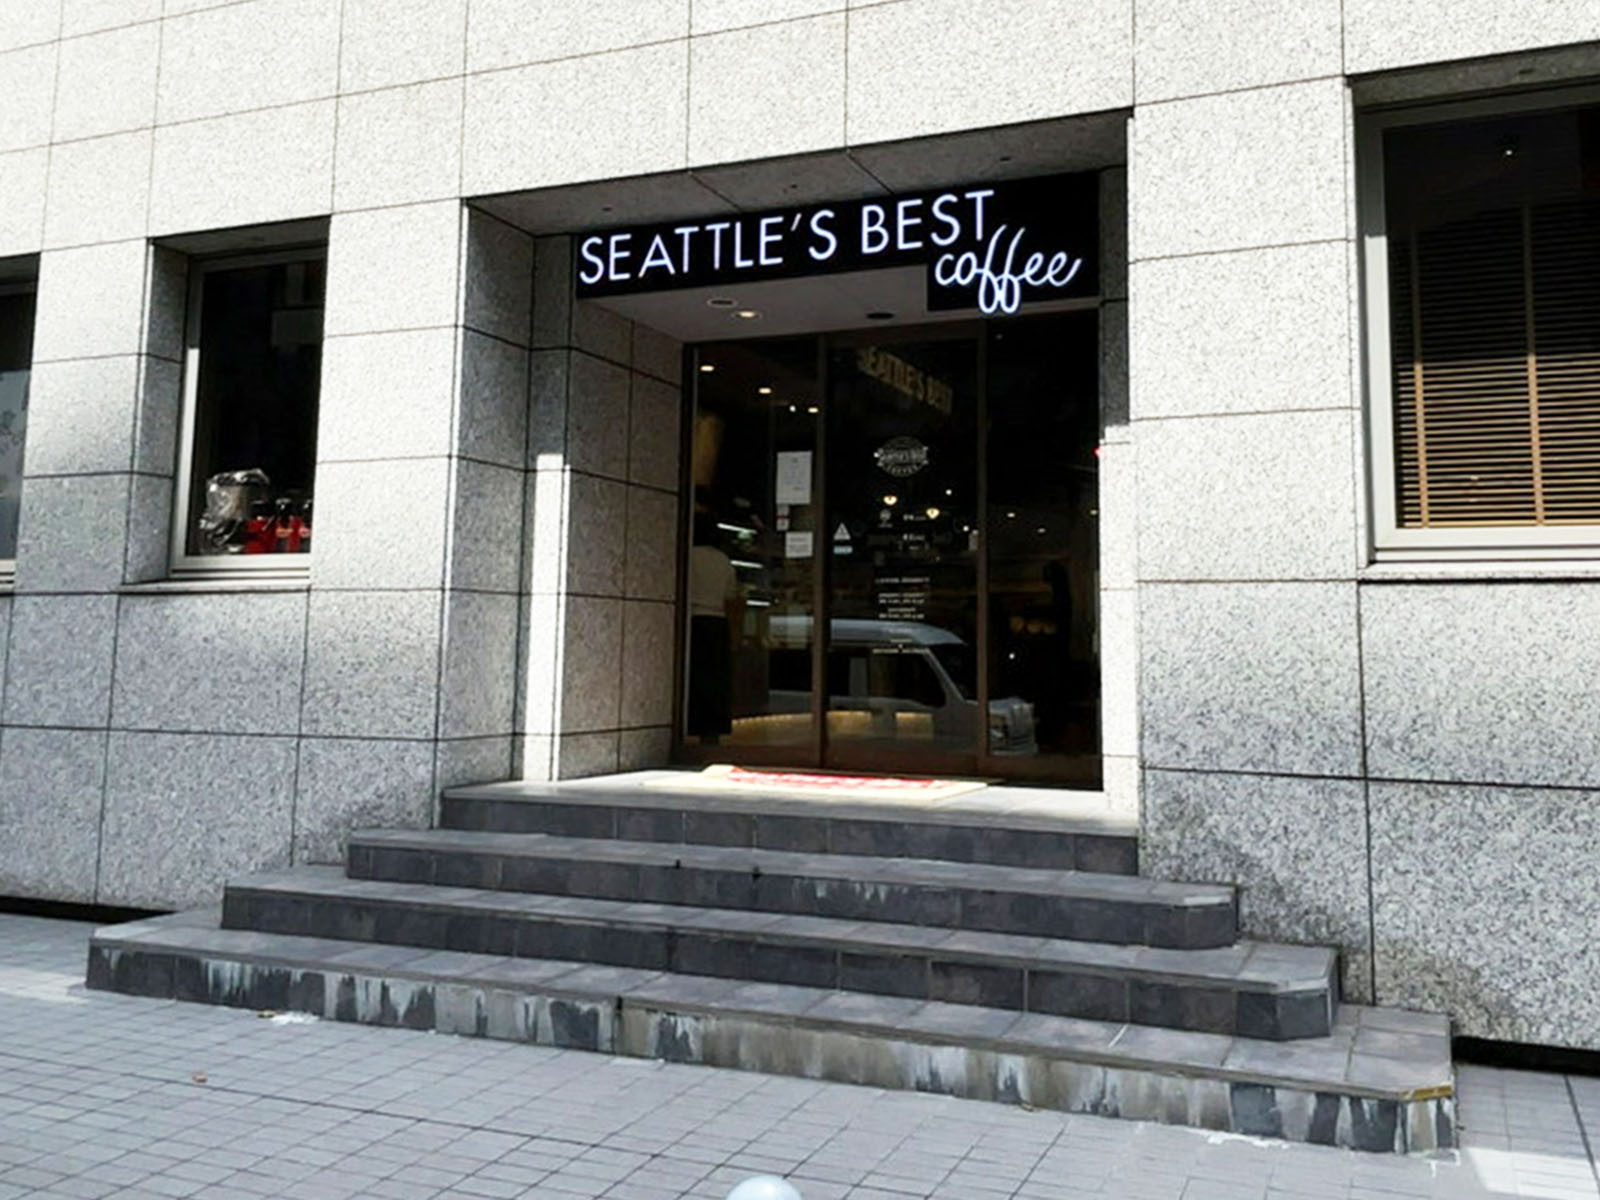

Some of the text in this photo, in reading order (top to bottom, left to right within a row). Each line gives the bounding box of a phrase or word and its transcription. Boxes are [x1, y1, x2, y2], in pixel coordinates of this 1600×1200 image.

[578, 188, 995, 285] SEATTLE'S BEST
[933, 223, 1083, 314] coffee
